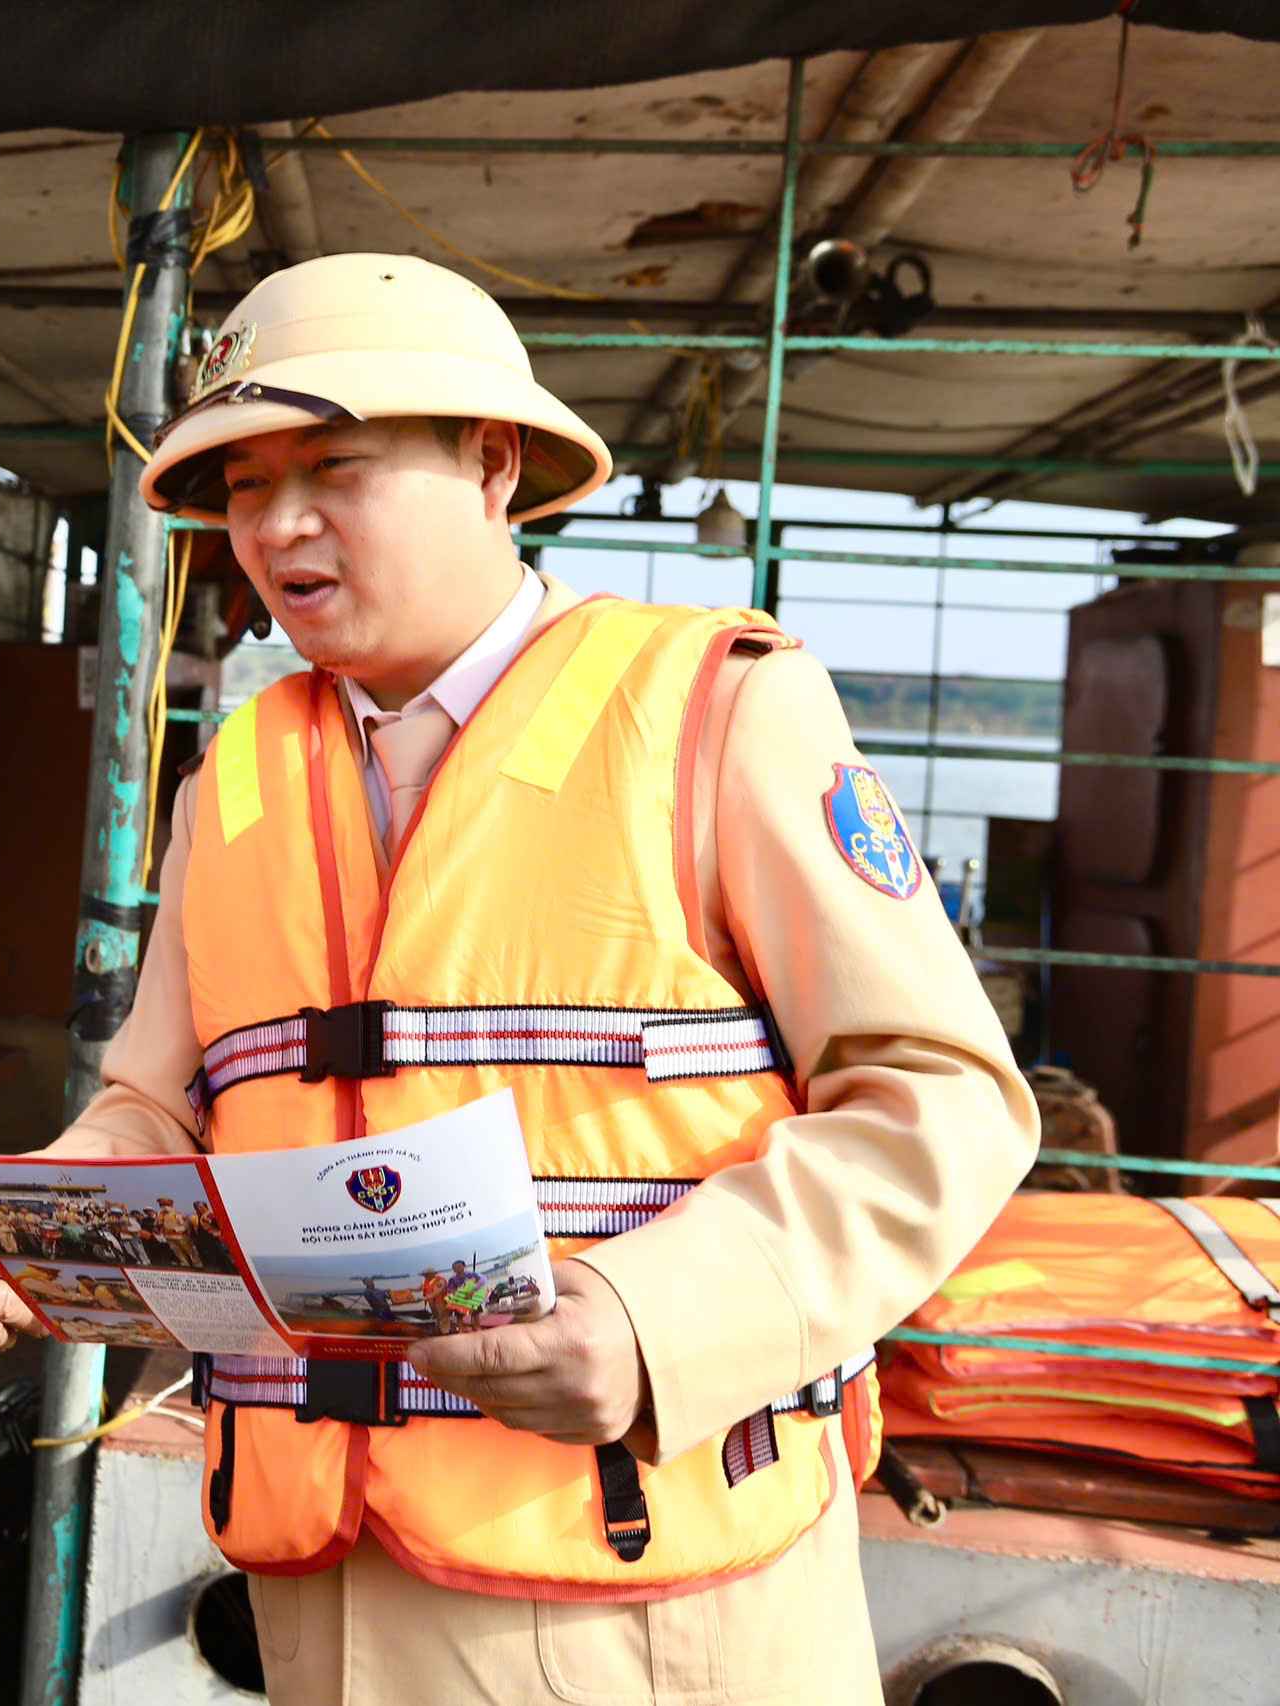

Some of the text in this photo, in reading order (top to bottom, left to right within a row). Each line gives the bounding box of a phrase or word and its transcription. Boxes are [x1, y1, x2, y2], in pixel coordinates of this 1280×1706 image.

[302, 1224, 341, 1235] PHÒNG
[377, 1216, 396, 1228] SÁT
[399, 1211, 427, 1224] GIAO
[429, 1200, 467, 1217] THÔNG
[358, 1228, 376, 1240] SÁT
[450, 1210, 464, 1223] SỐ
